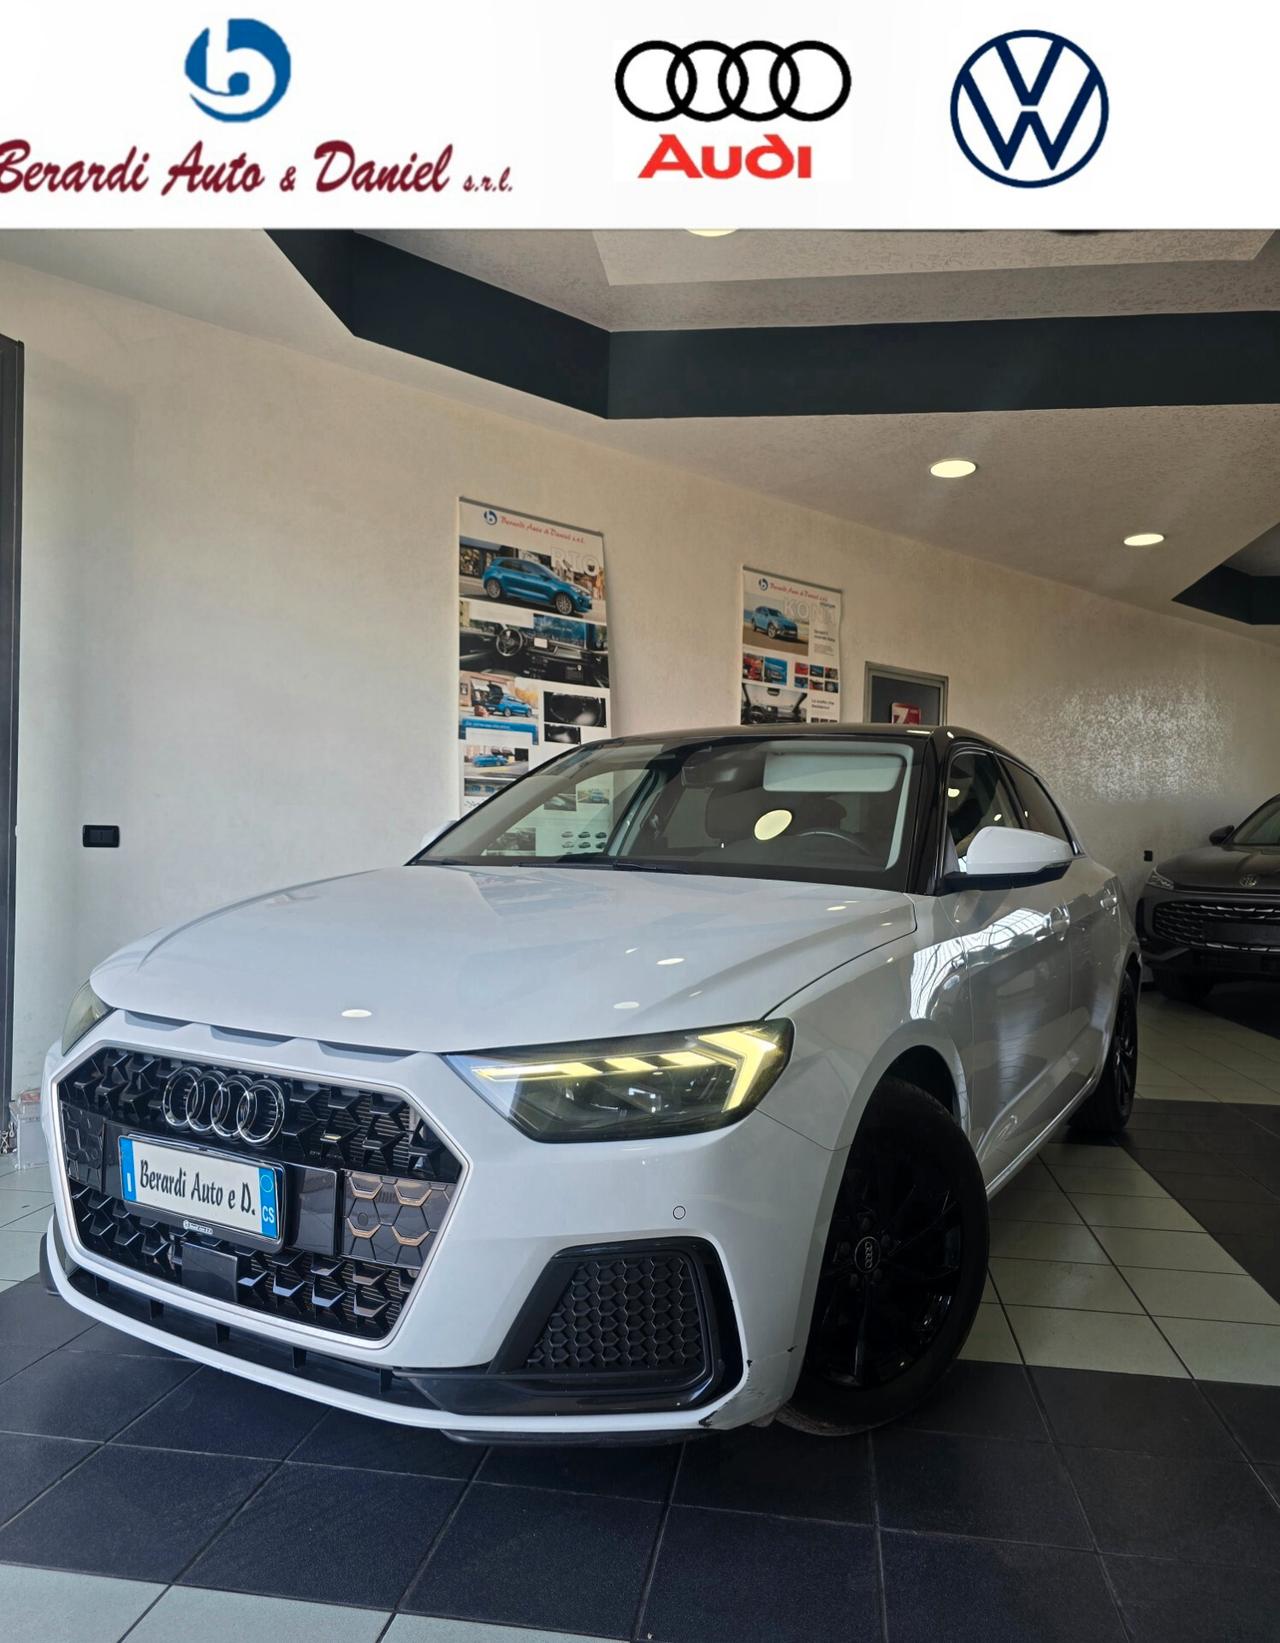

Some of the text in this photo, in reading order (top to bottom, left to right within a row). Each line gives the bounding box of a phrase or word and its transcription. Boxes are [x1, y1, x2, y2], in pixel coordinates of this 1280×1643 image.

[550, 546, 600, 576] RIO
[140, 1159, 256, 1216] Berardi Auto e D.
[262, 1206, 275, 1224] CS
